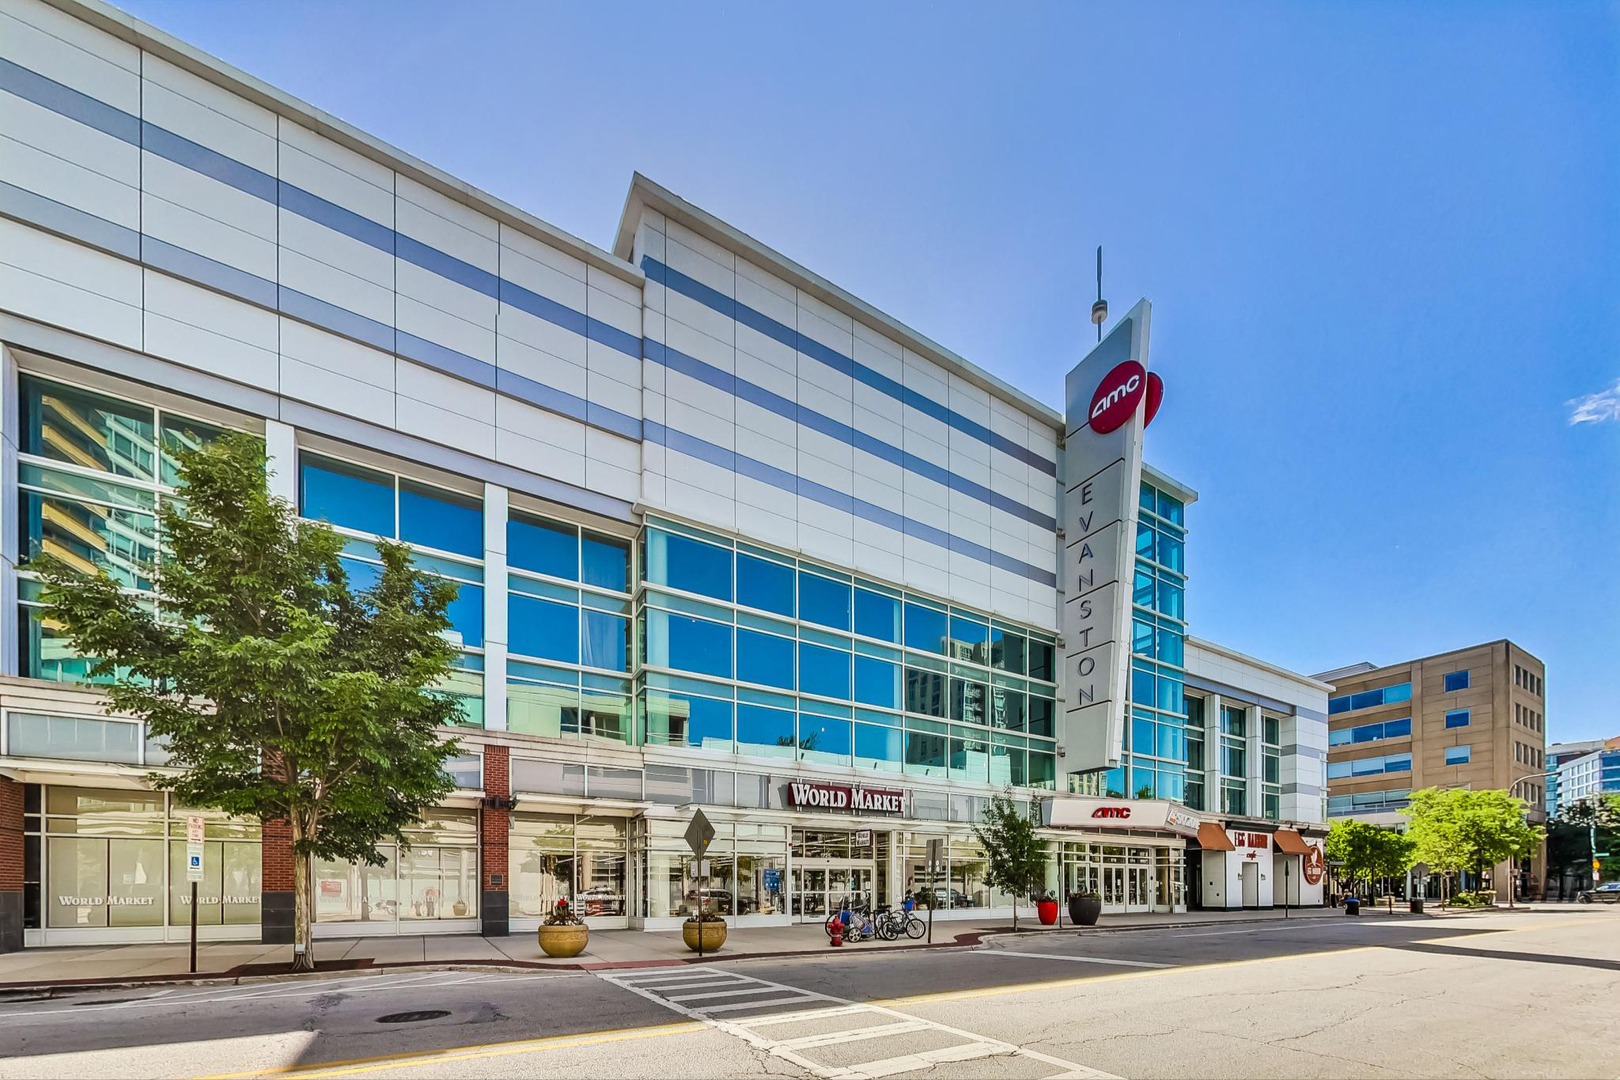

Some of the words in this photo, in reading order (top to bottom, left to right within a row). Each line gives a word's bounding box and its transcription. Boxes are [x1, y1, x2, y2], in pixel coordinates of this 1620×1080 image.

[1078, 482, 1096, 706] EVANSTON
[791, 783, 848, 808] WORLD
[850, 788, 907, 812] MARKET
[1234, 831, 1246, 847] EGG
[59, 895, 103, 906] WORLD
[106, 895, 154, 906] MARKET
[180, 895, 219, 905] WRLD
